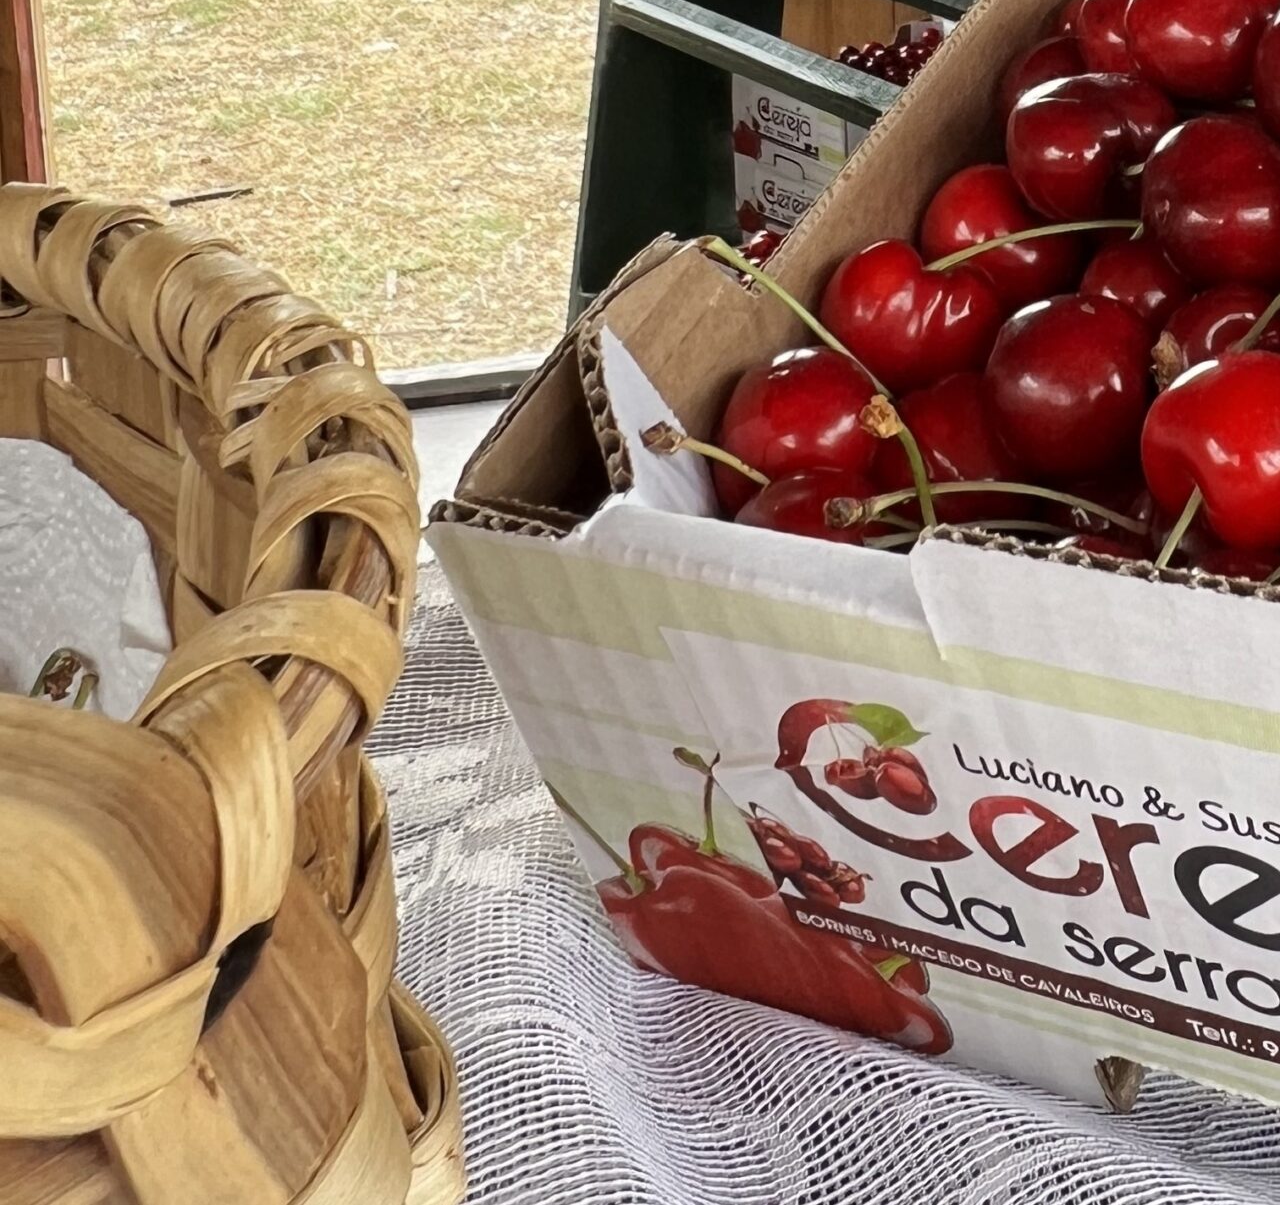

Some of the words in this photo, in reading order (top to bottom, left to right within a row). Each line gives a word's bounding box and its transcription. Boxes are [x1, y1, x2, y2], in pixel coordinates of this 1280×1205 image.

[757, 96, 812, 142] Cereja
[952, 743, 1125, 807] Luciano
[1142, 786, 1185, 822] &
[900, 867, 1027, 948] da
[795, 909, 876, 944] BORNES
[891, 936, 982, 974] MACEDO
[987, 964, 1016, 984] DE
[1019, 974, 1156, 1025] CAVALEIROS
